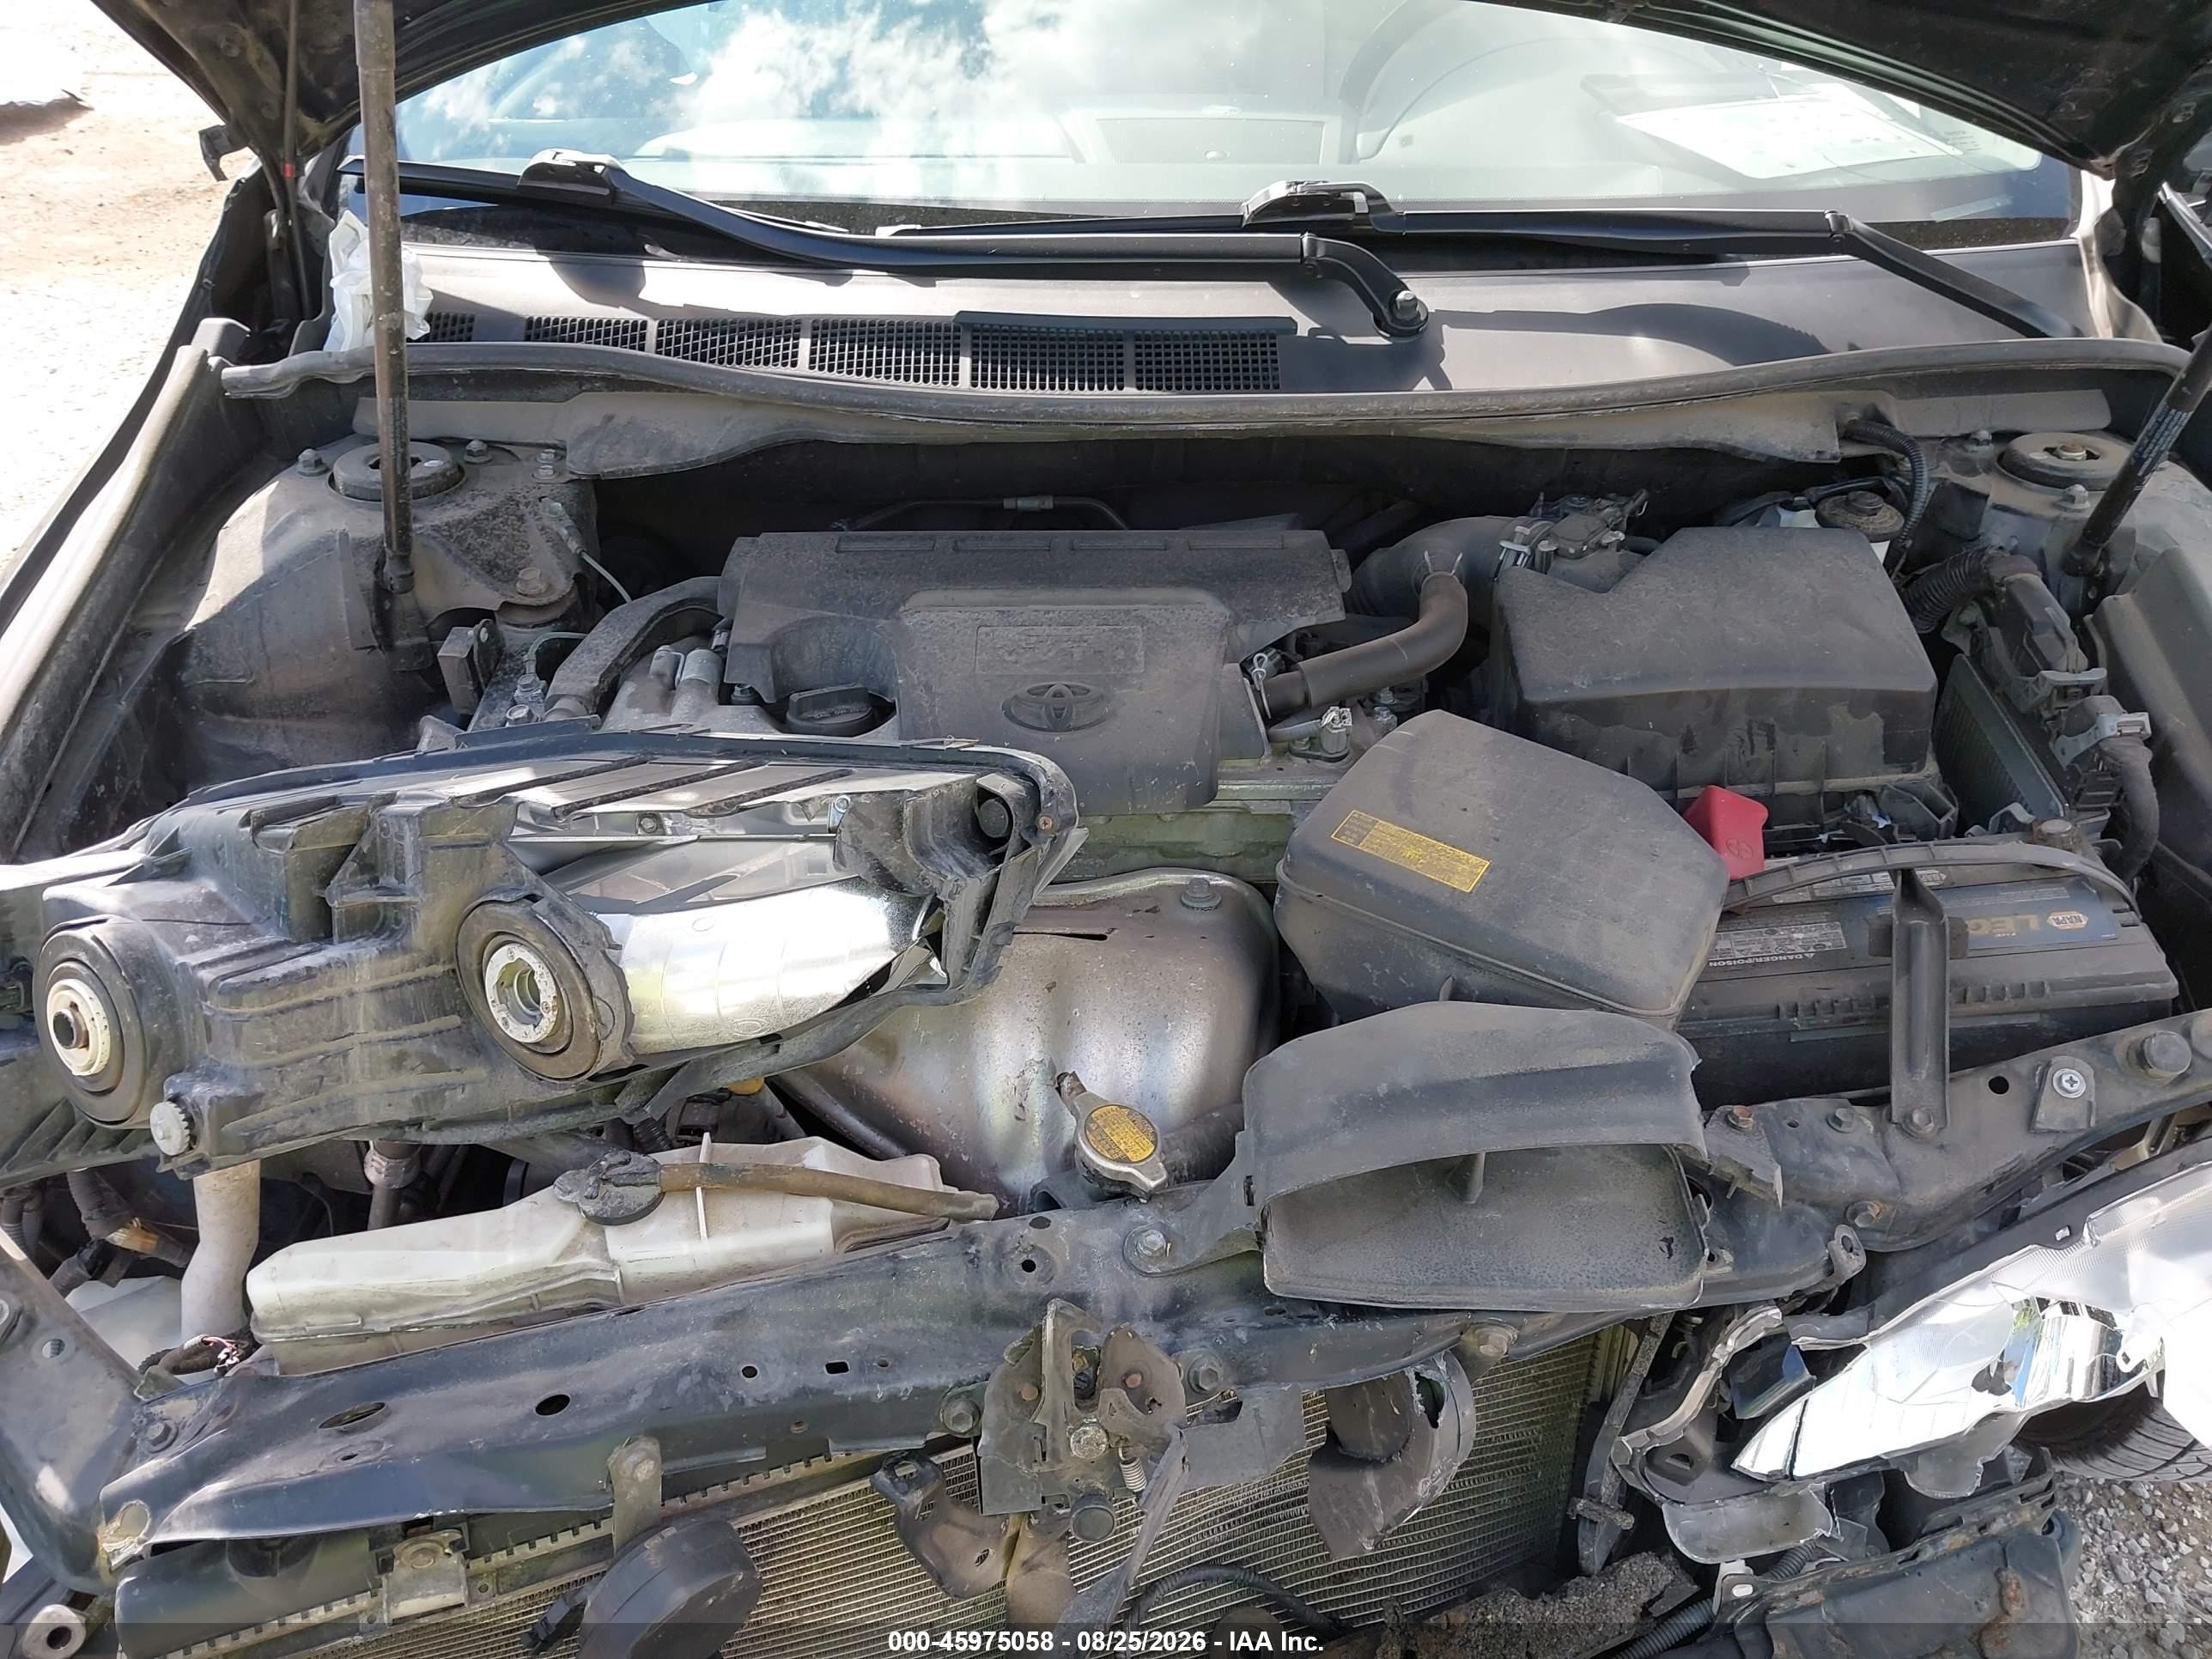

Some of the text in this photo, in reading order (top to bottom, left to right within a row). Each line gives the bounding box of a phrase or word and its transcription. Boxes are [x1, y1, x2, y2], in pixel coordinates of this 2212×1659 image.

[1966, 915, 2039, 934] LEG
[2051, 914, 2084, 927] NAPA
[1708, 953, 1803, 968] DANGER/POISON
